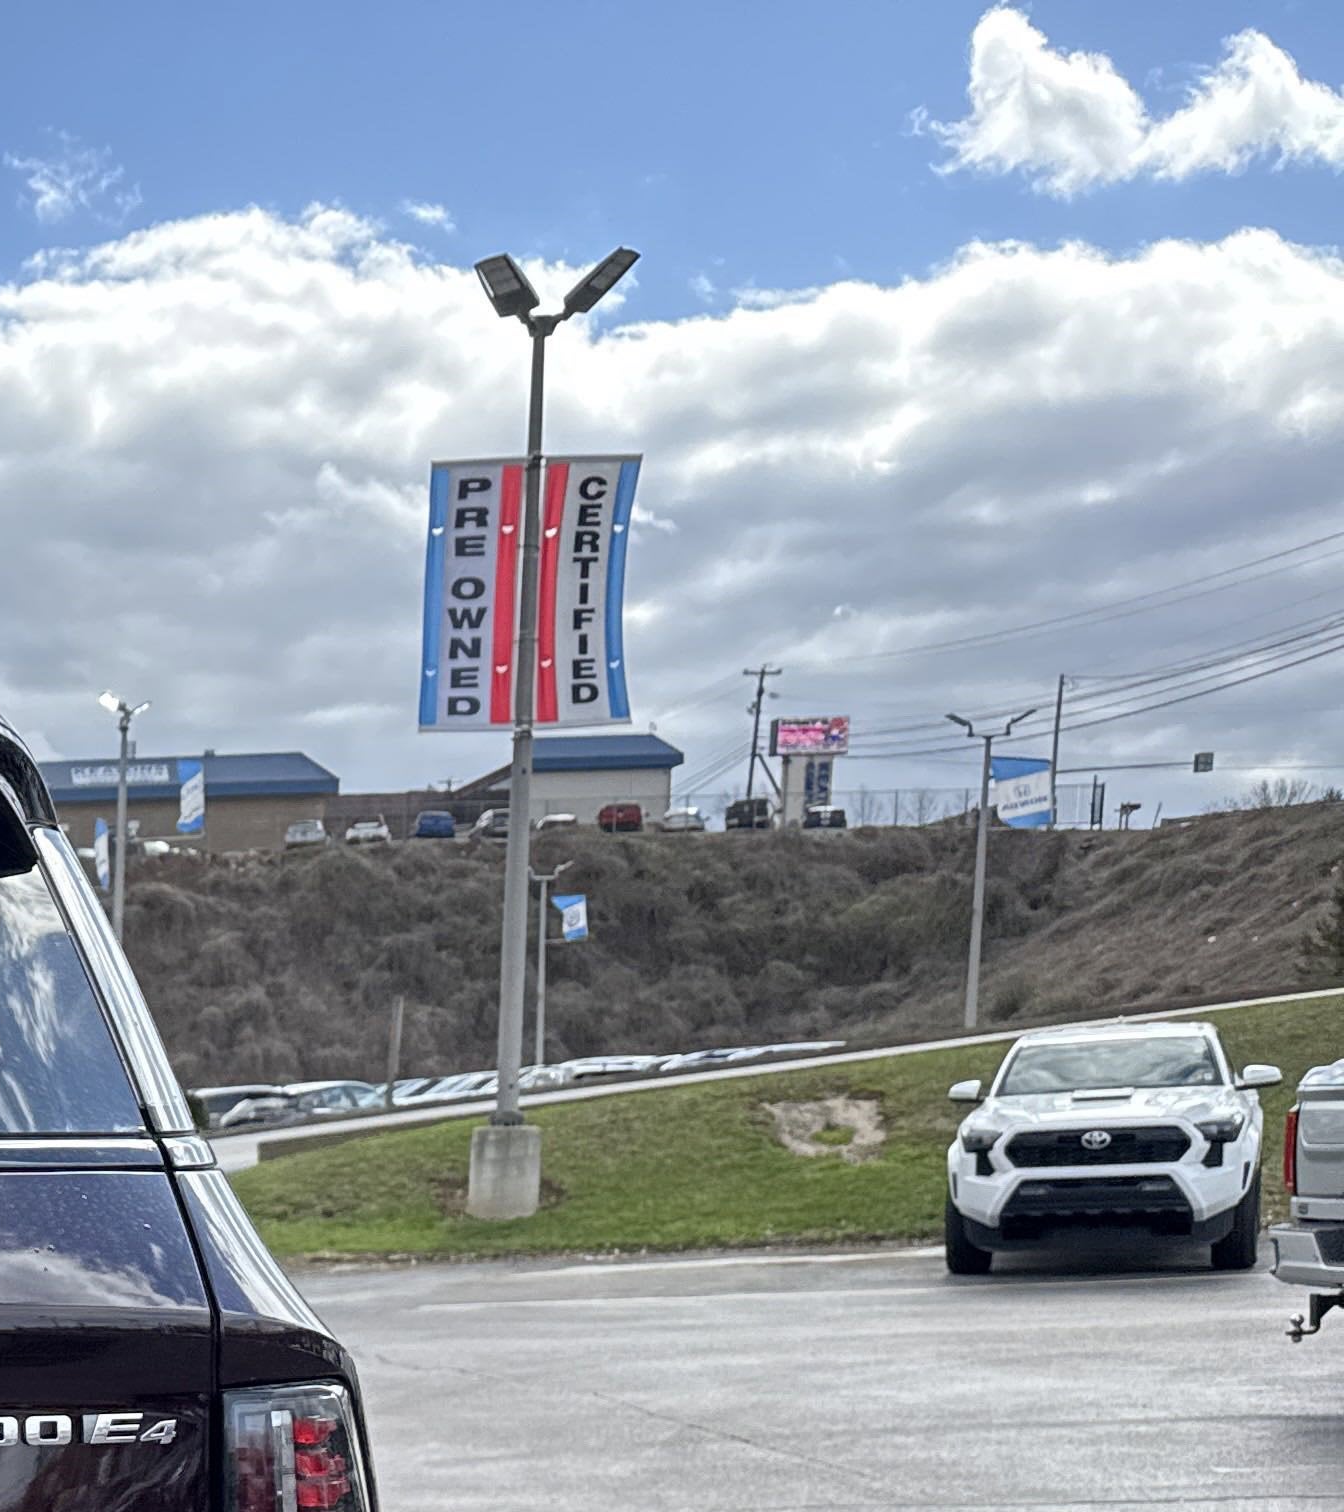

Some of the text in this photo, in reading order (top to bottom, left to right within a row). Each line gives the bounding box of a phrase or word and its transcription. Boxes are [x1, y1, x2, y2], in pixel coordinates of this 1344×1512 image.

[447, 477, 492, 717] PRE OWNED
[571, 475, 608, 704] CERTIFIED
